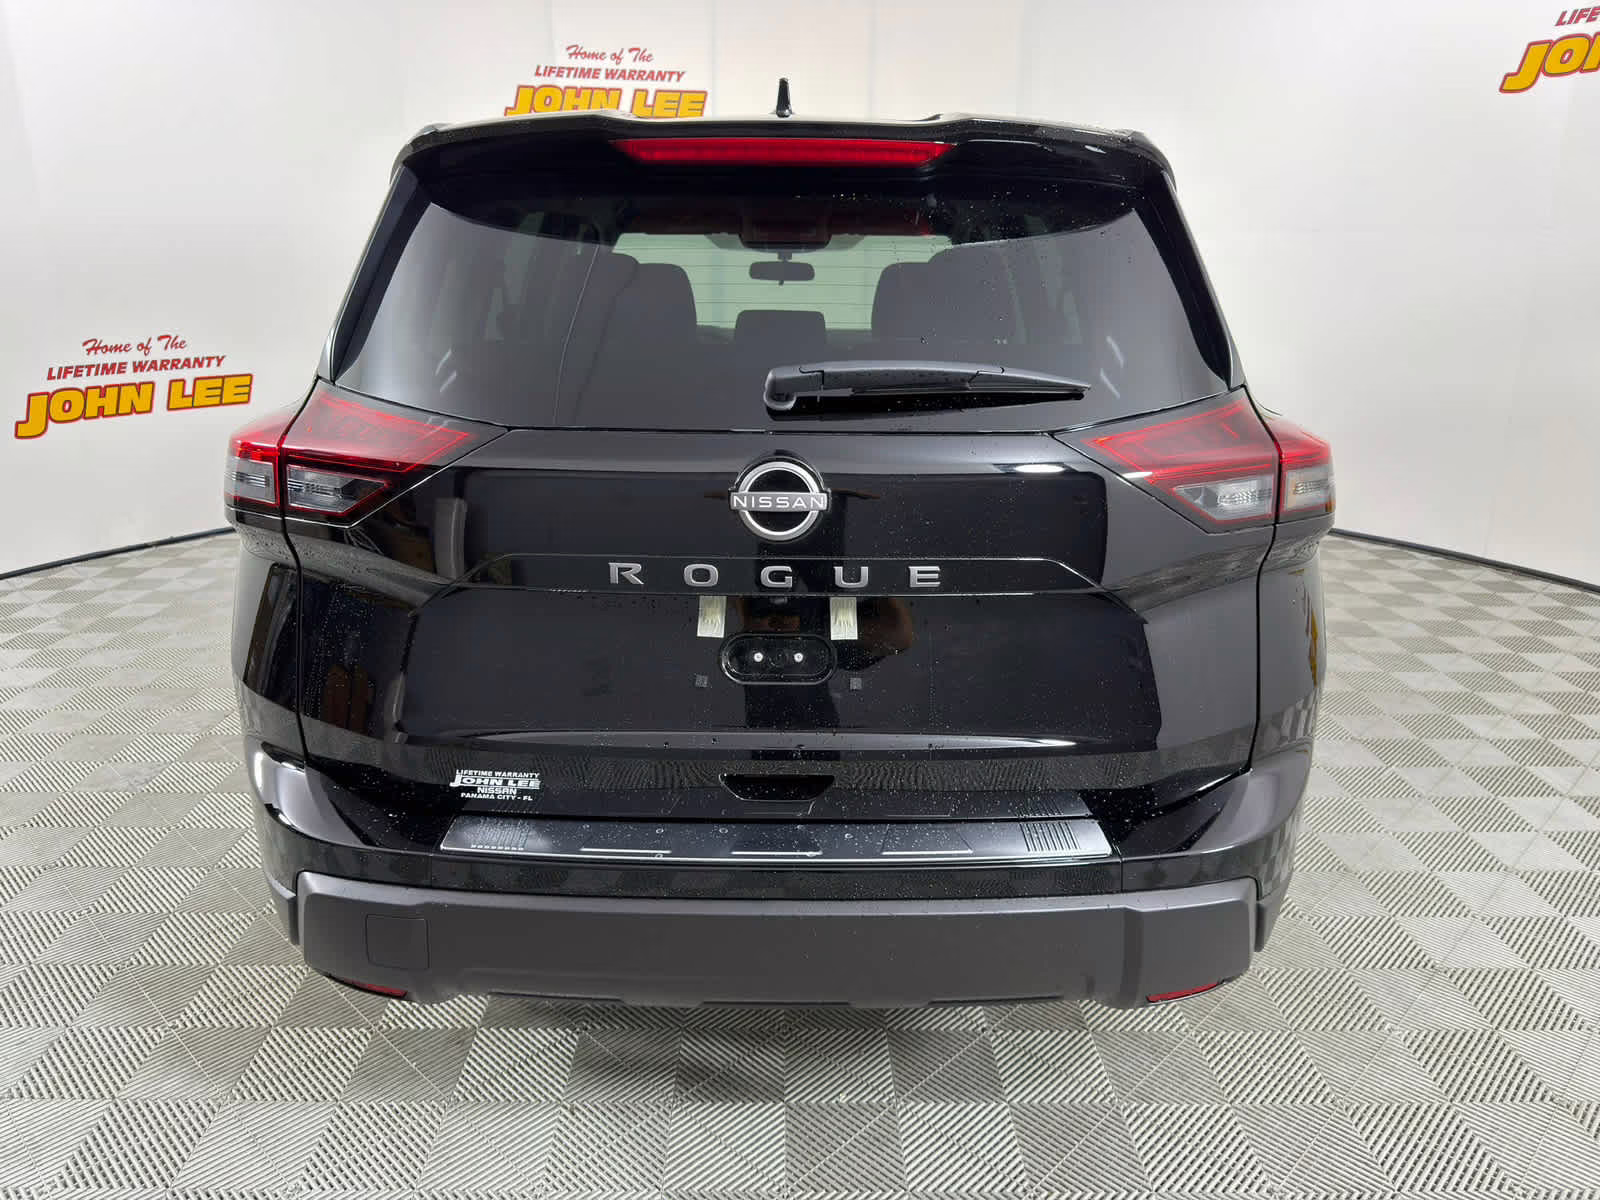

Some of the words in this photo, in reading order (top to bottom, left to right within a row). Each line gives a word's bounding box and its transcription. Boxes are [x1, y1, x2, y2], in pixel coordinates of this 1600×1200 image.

[566, 44, 608, 62] Home
[609, 49, 625, 65] of
[627, 48, 654, 63] The
[534, 65, 601, 80] LIFETIME
[604, 70, 686, 82] WARRANTY
[503, 84, 623, 117] JOHN
[630, 88, 708, 118] LEE
[82, 338, 132, 356] Home
[136, 337, 153, 356] of
[157, 334, 187, 351] The
[47, 361, 128, 381] LIFETIME
[132, 355, 226, 374] WARRANTY
[14, 381, 156, 440] JOHN
[166, 373, 253, 411] LEE
[733, 495, 825, 509] NISSAN
[608, 562, 942, 588] ROGUE
[449, 774, 503, 787] JOHN
[507, 779, 541, 789] LEE
[456, 769, 492, 777] LIFETIME
[460, 792, 495, 800] PANAMA
[476, 786, 517, 795] NISSAN
